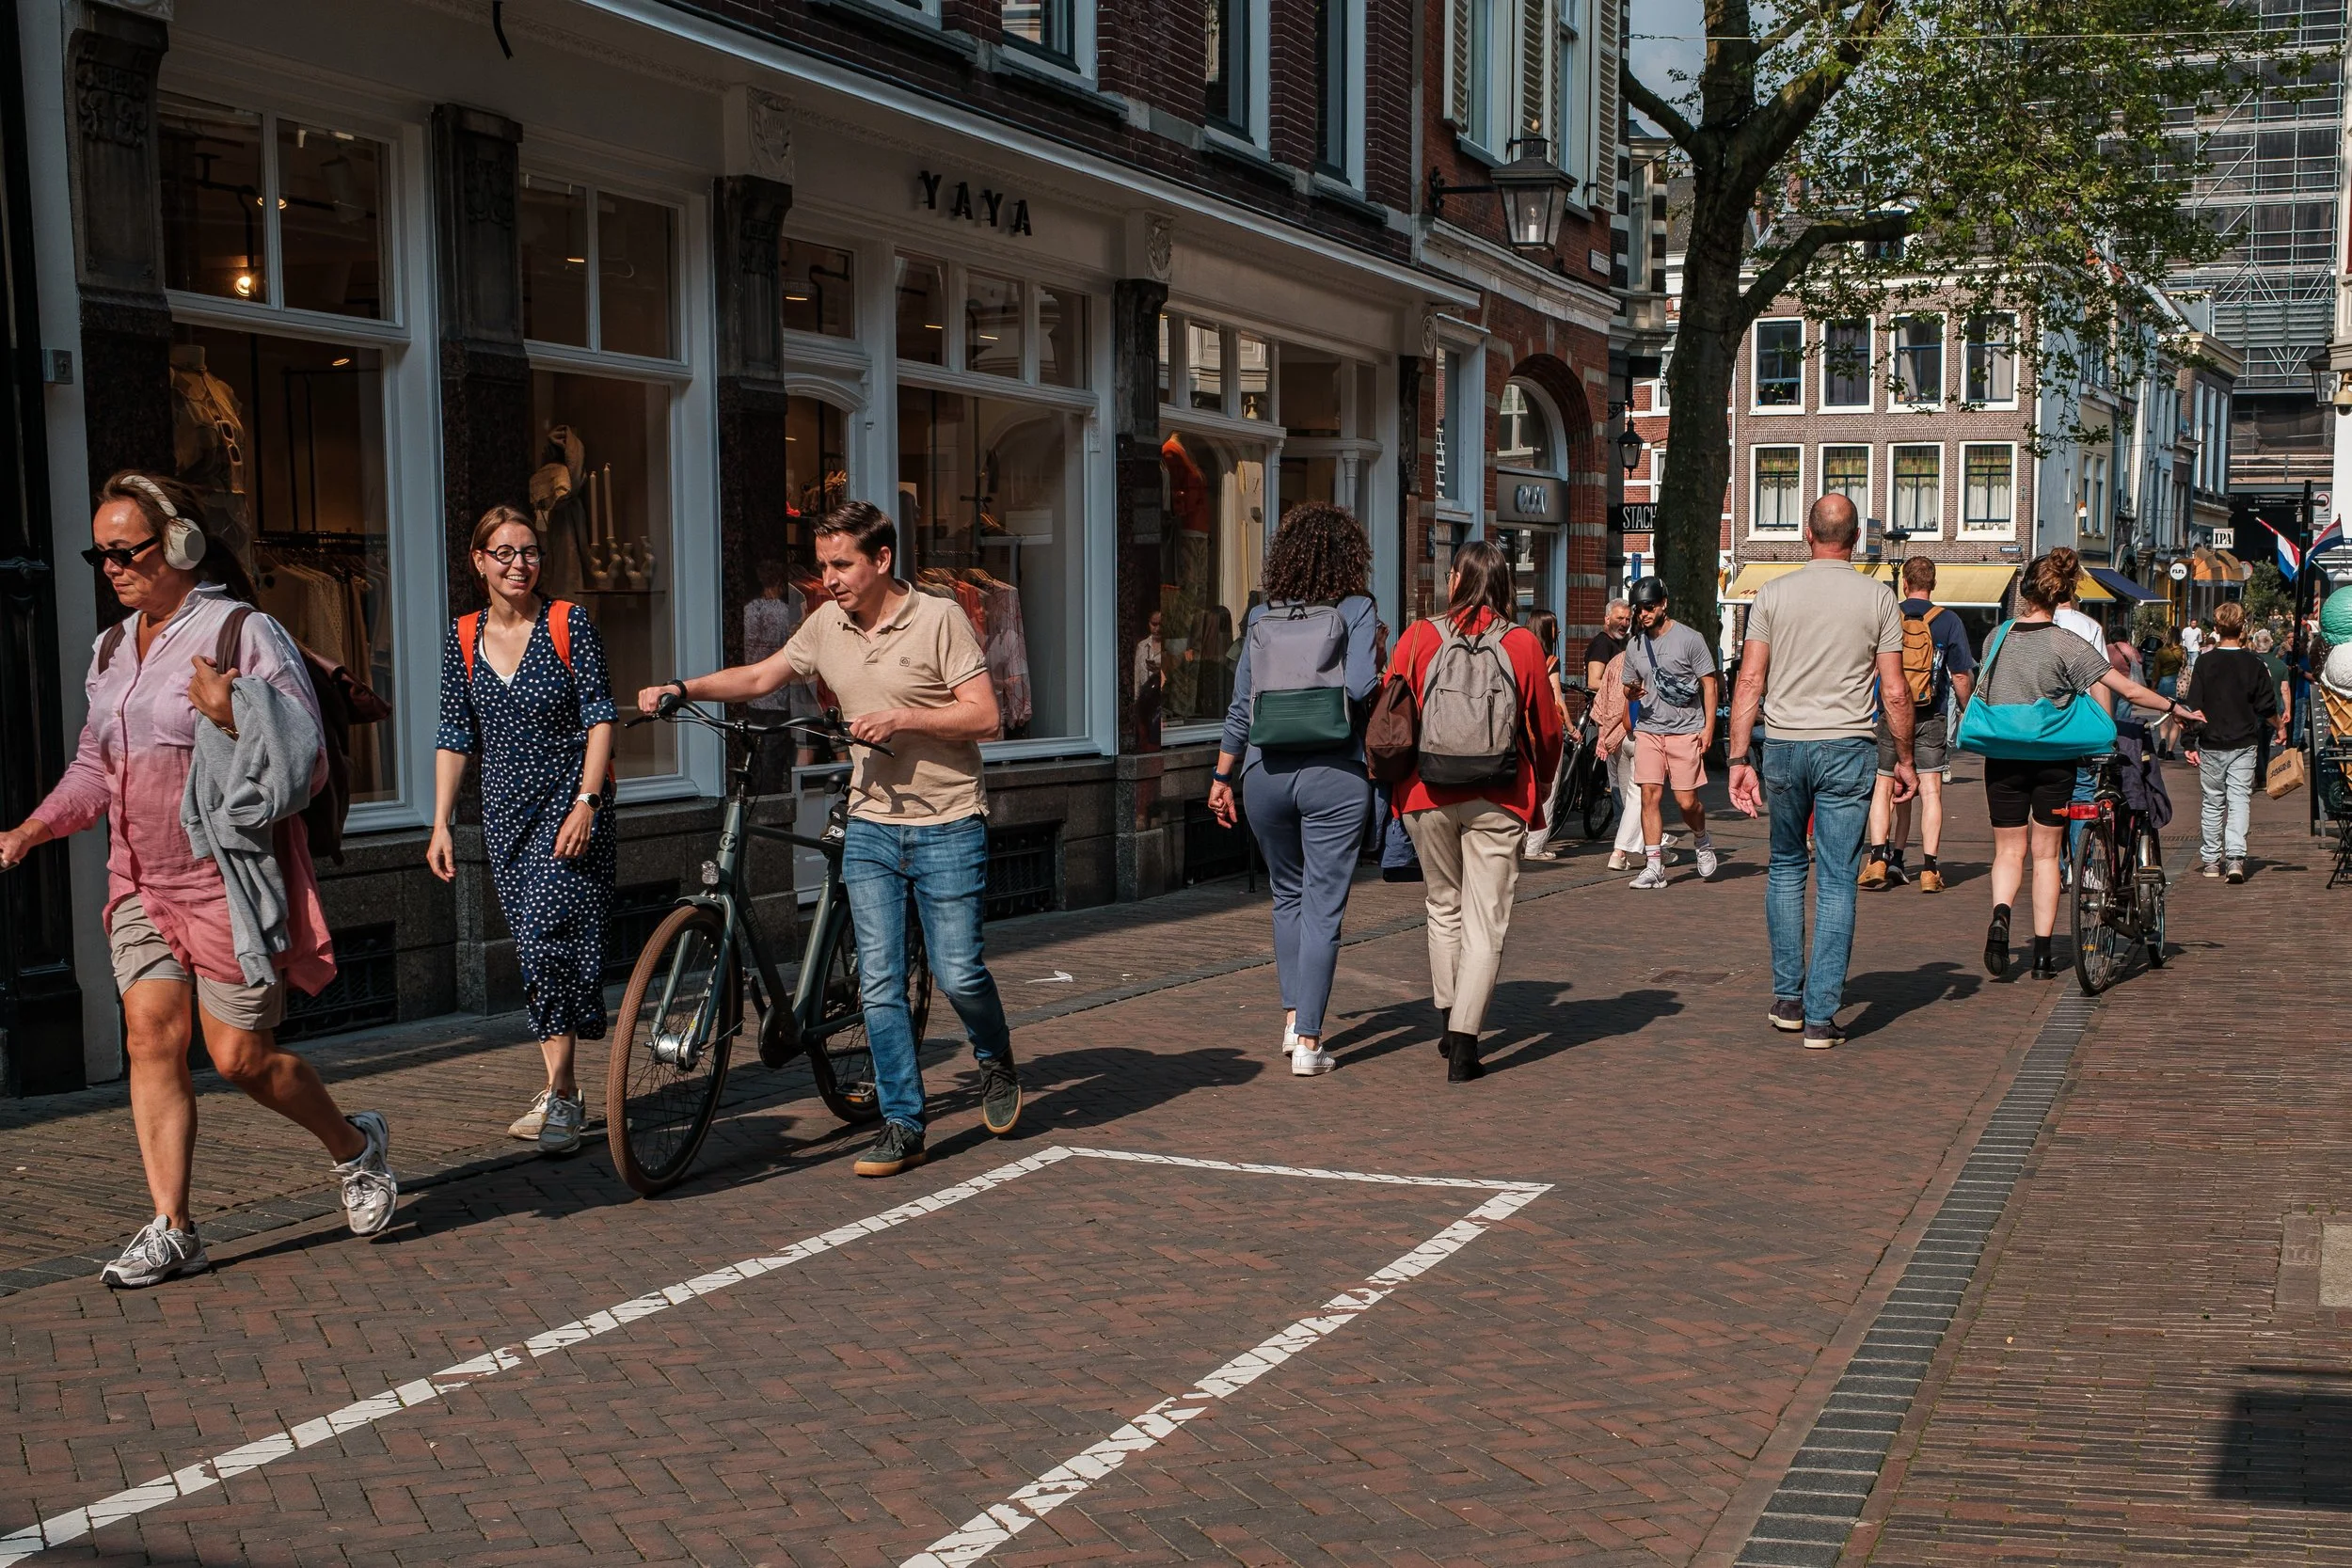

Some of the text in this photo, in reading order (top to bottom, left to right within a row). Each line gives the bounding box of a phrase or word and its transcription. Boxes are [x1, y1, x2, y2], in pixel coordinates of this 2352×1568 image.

[920, 170, 1033, 236] YAYA
[1623, 506, 1657, 529] STACH
[2215, 532, 2233, 545] IPA
